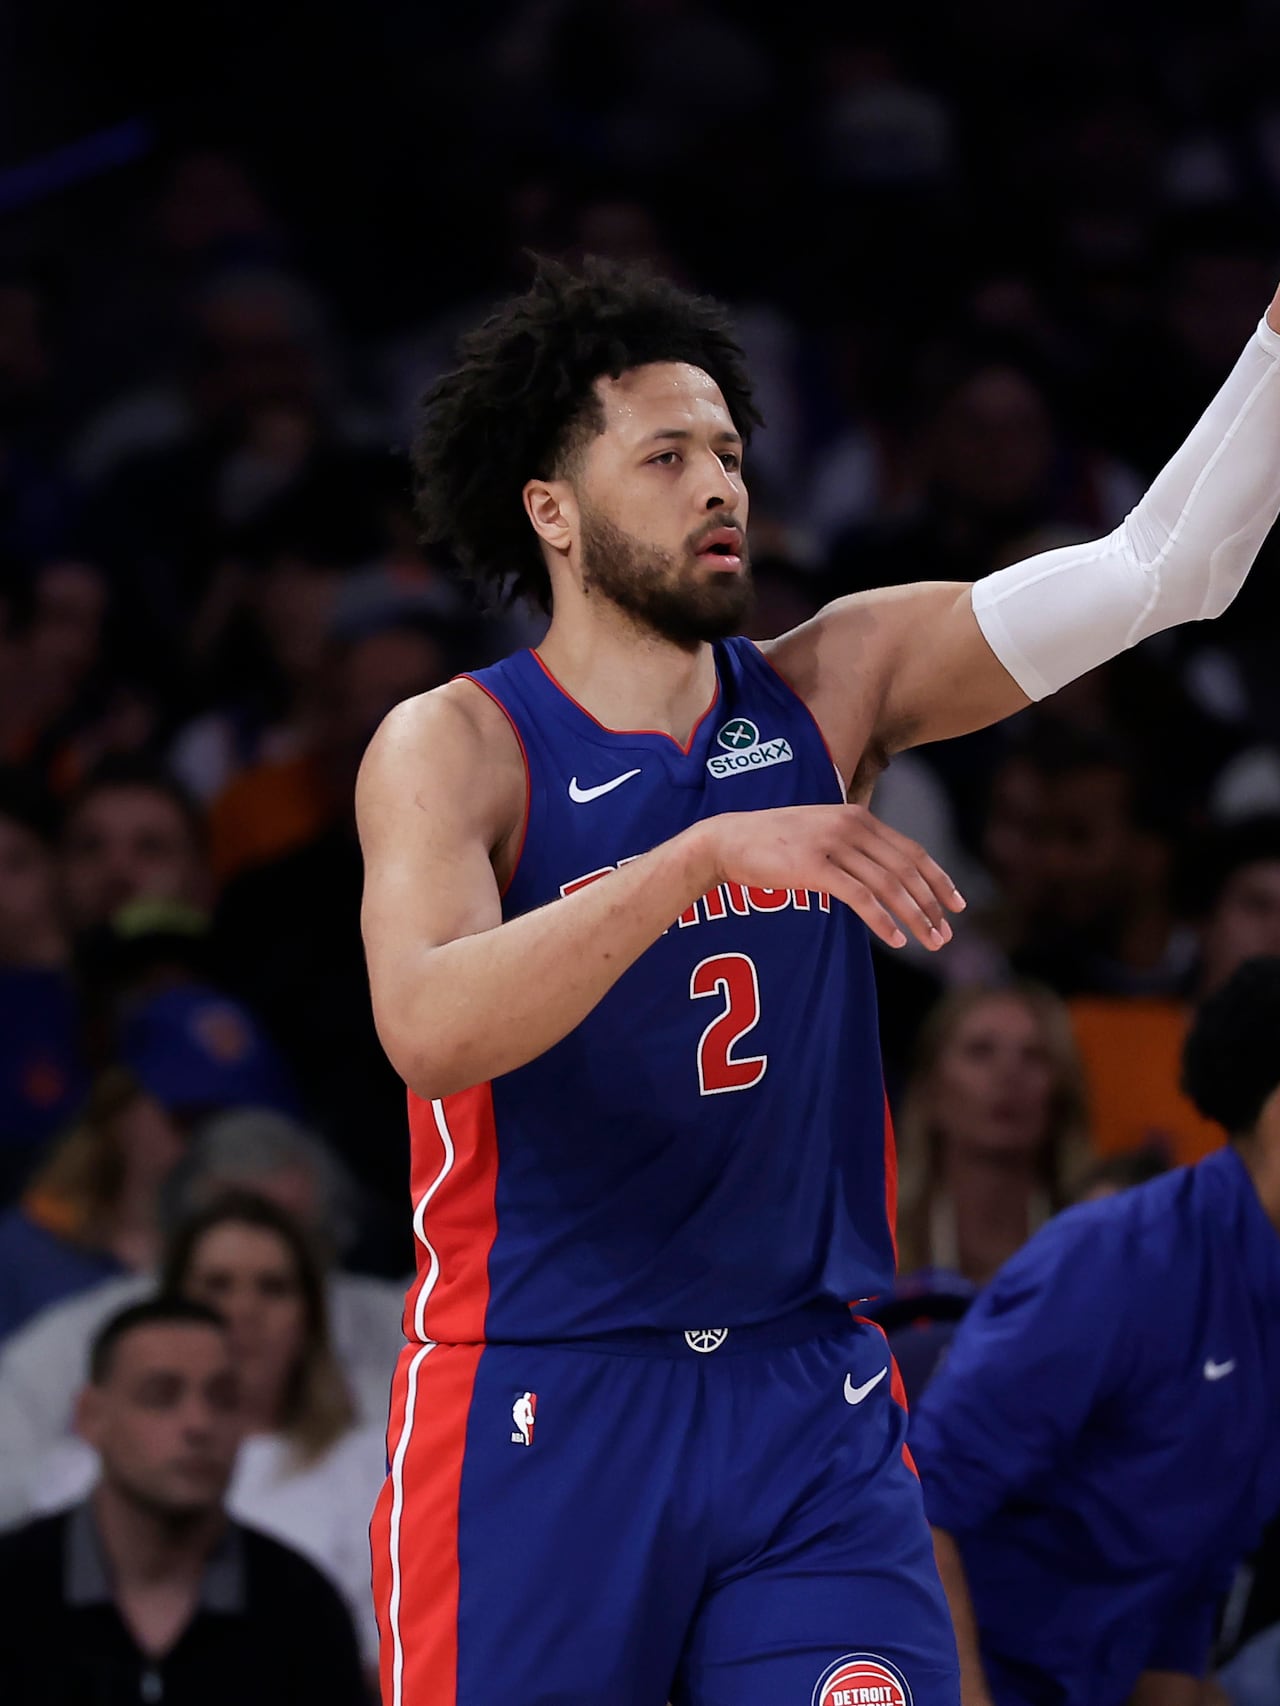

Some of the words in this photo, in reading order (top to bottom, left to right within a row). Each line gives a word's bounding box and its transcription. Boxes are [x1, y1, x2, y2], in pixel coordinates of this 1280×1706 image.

[710, 741, 791, 773] StockX
[690, 952, 767, 1096] 2
[831, 1686, 892, 1706] DETROIT
